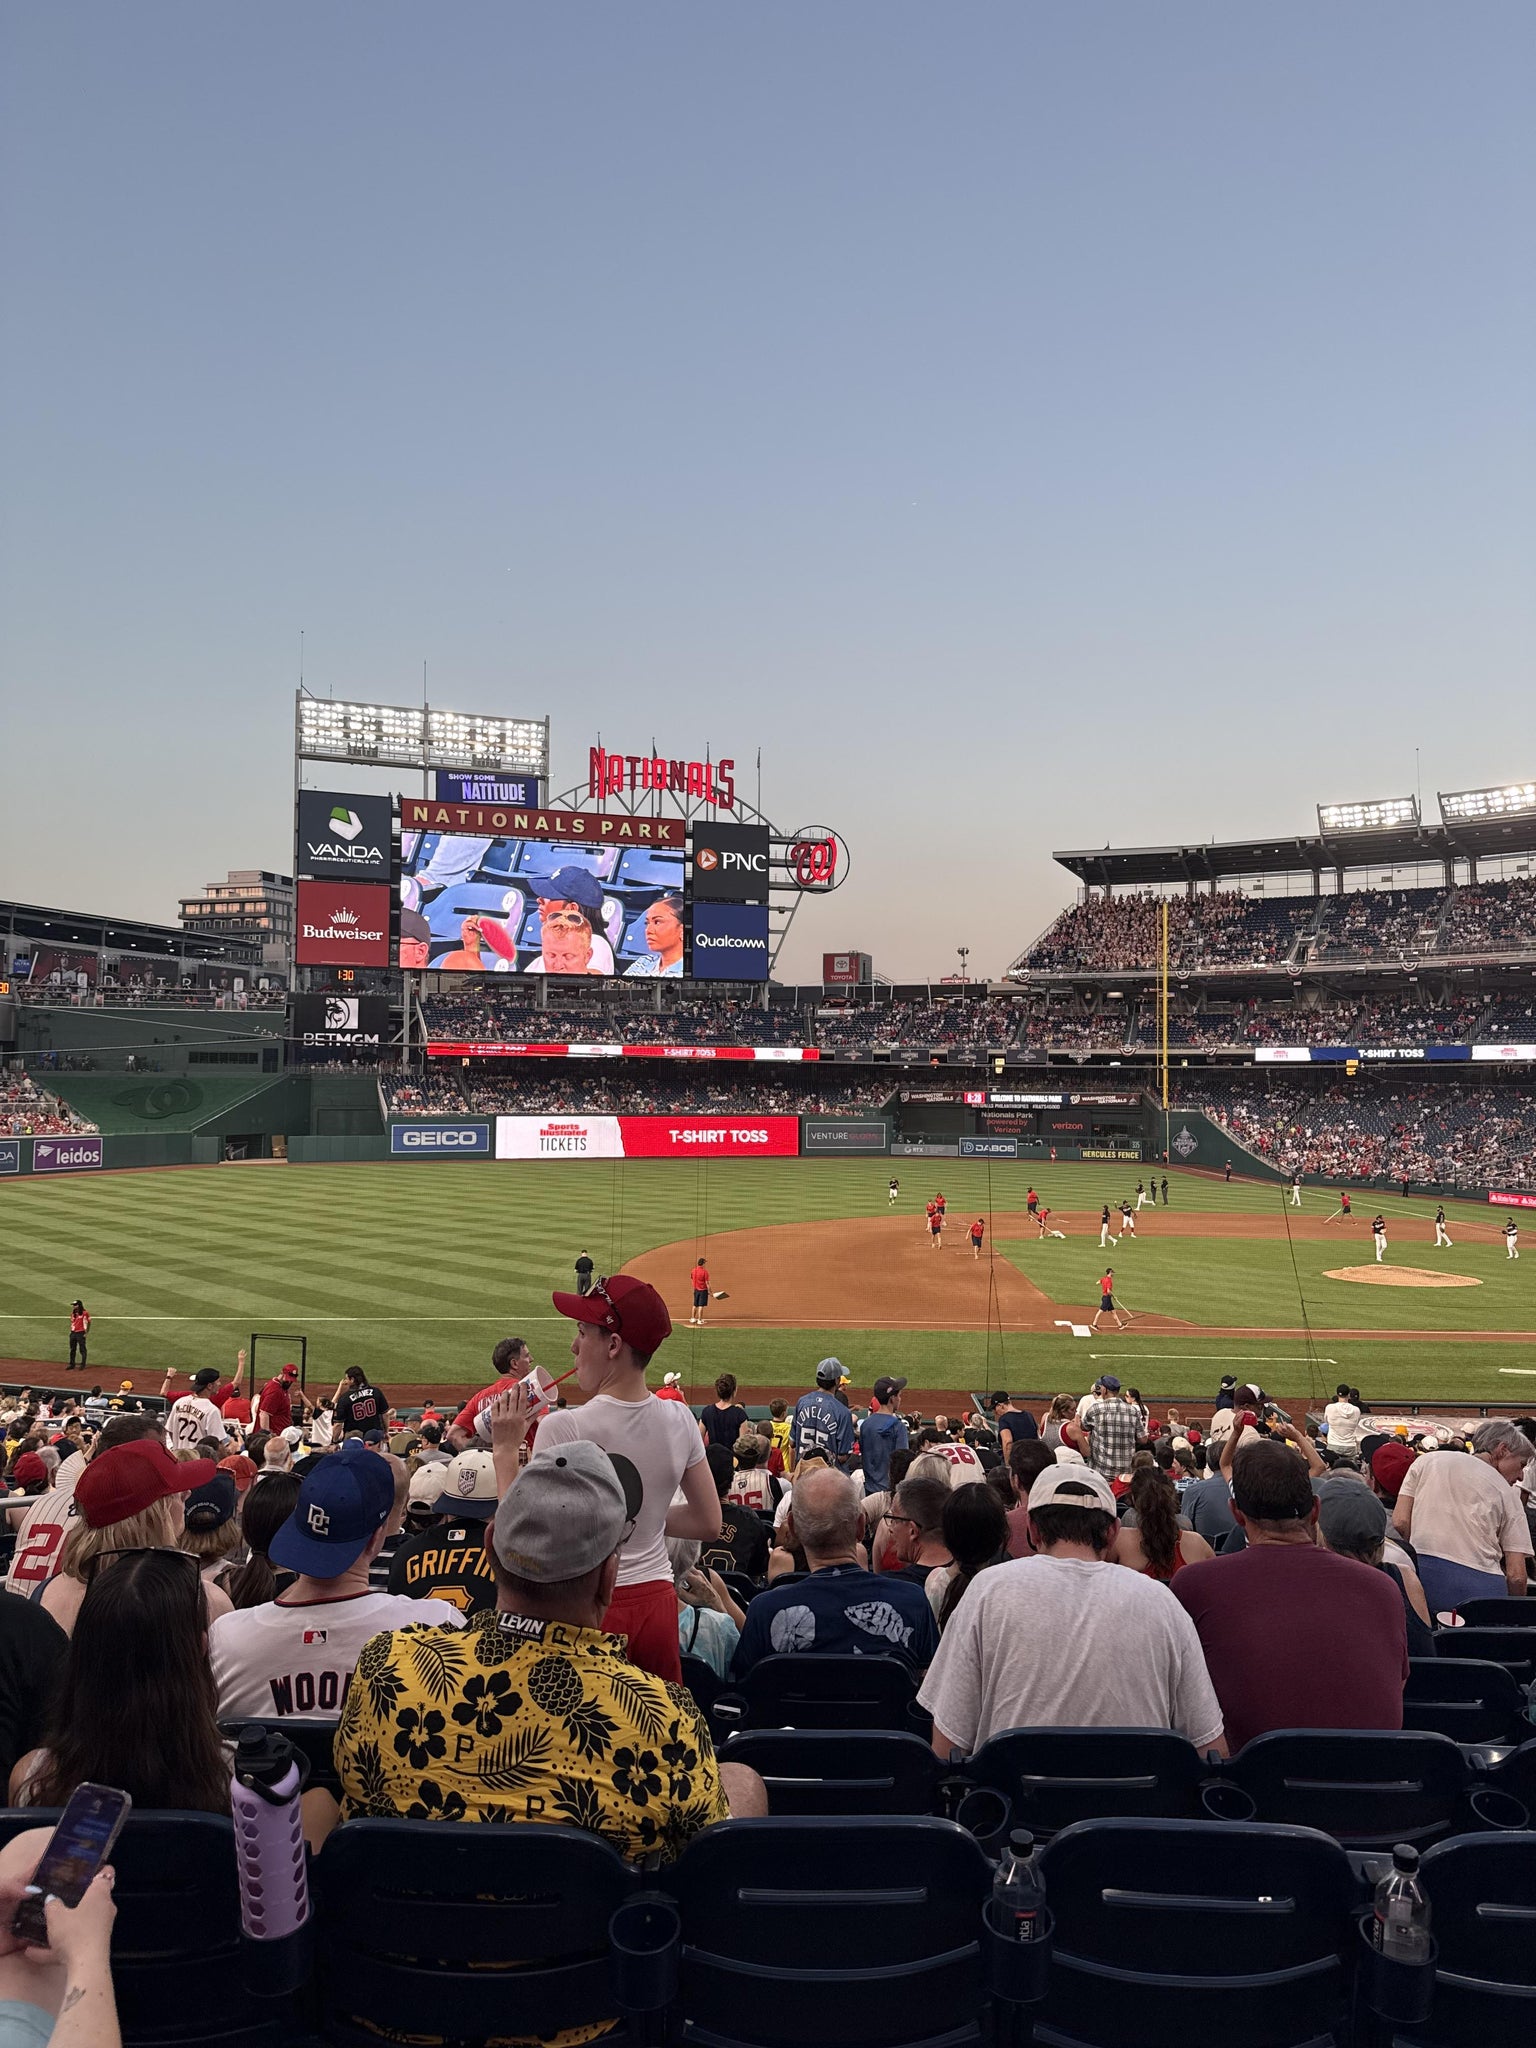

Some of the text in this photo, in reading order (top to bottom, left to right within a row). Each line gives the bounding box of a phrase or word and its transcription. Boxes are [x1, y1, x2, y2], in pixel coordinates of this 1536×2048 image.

[448, 773, 471, 781] SHOW
[589, 747, 735, 809] NATIONALS
[462, 782, 526, 801] NATITUDE
[413, 806, 672, 840] NATIONALS PARK
[307, 842, 384, 860] VANDA
[310, 855, 369, 865] PHARMACEUTICALS
[721, 851, 767, 872] PNC
[303, 923, 384, 941] Budweiser
[695, 933, 766, 949] Qualcomm
[337, 970, 354, 981] 1:30
[303, 1033, 380, 1047] BETMGM
[663, 1048, 716, 1057] T-SHIRT TOSS
[1358, 1048, 1425, 1059] T-SHIRT TOSS
[910, 1092, 943, 1100] WASHINGTON
[926, 1095, 954, 1103] NATIONALS
[990, 1094, 1062, 1103] WELCOME TO NATIONALS PARK
[1097, 1097, 1127, 1105] NATIONALS
[986, 1118, 1028, 1127] powered by
[1016, 1111, 1034, 1119] Park
[540, 1128, 588, 1137] Illustrated
[547, 1123, 580, 1131] Sports
[1052, 1121, 1083, 1130] verizon
[402, 1130, 477, 1147] GEICO
[669, 1129, 768, 1144] T-SHIRT TOSS
[811, 1132, 848, 1140] VENTURE
[540, 1137, 586, 1152] TICKETS
[974, 1144, 1015, 1153] DABOS
[56, 1146, 99, 1165] leidos
[1082, 1150, 1139, 1160] HERCULES FENCE
[348, 1387, 374, 1403] CHAVEZ
[351, 1398, 377, 1421] 60
[178, 1417, 199, 1443] 22
[938, 1446, 976, 1466] 26
[13, 1523, 69, 1581] 2
[499, 1612, 545, 1635] LEVIN
[455, 1734, 475, 1763] P
[526, 1795, 546, 1820] P
